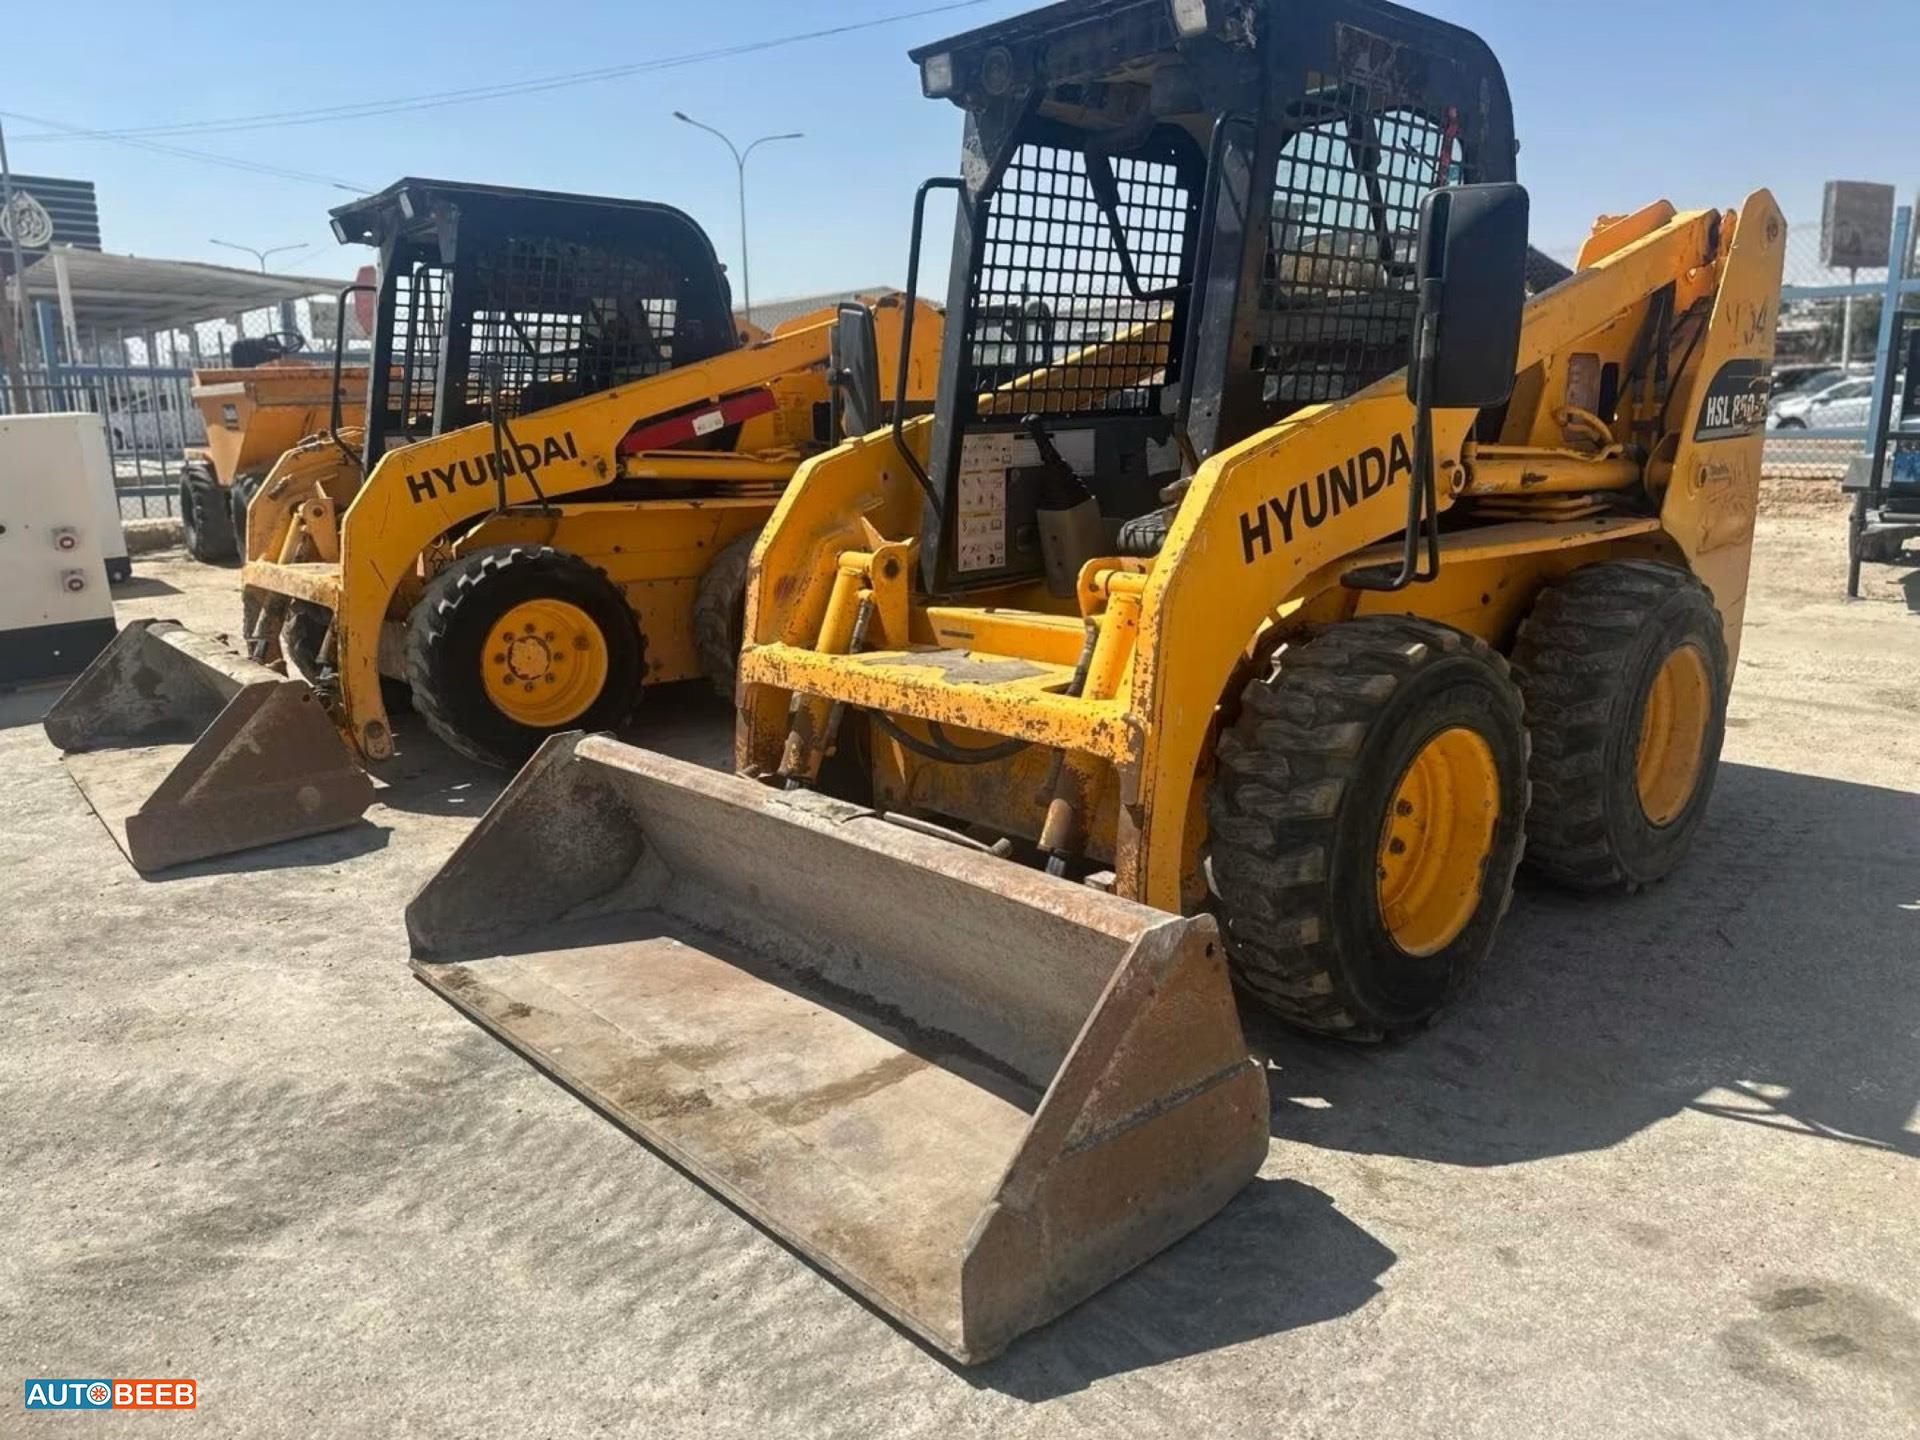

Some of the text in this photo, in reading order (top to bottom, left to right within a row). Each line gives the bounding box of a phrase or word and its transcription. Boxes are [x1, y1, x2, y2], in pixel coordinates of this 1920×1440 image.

[1706, 395, 1729, 426] HSL
[406, 431, 577, 504] HYUNDAI
[1239, 427, 1415, 564] HYUNDA
